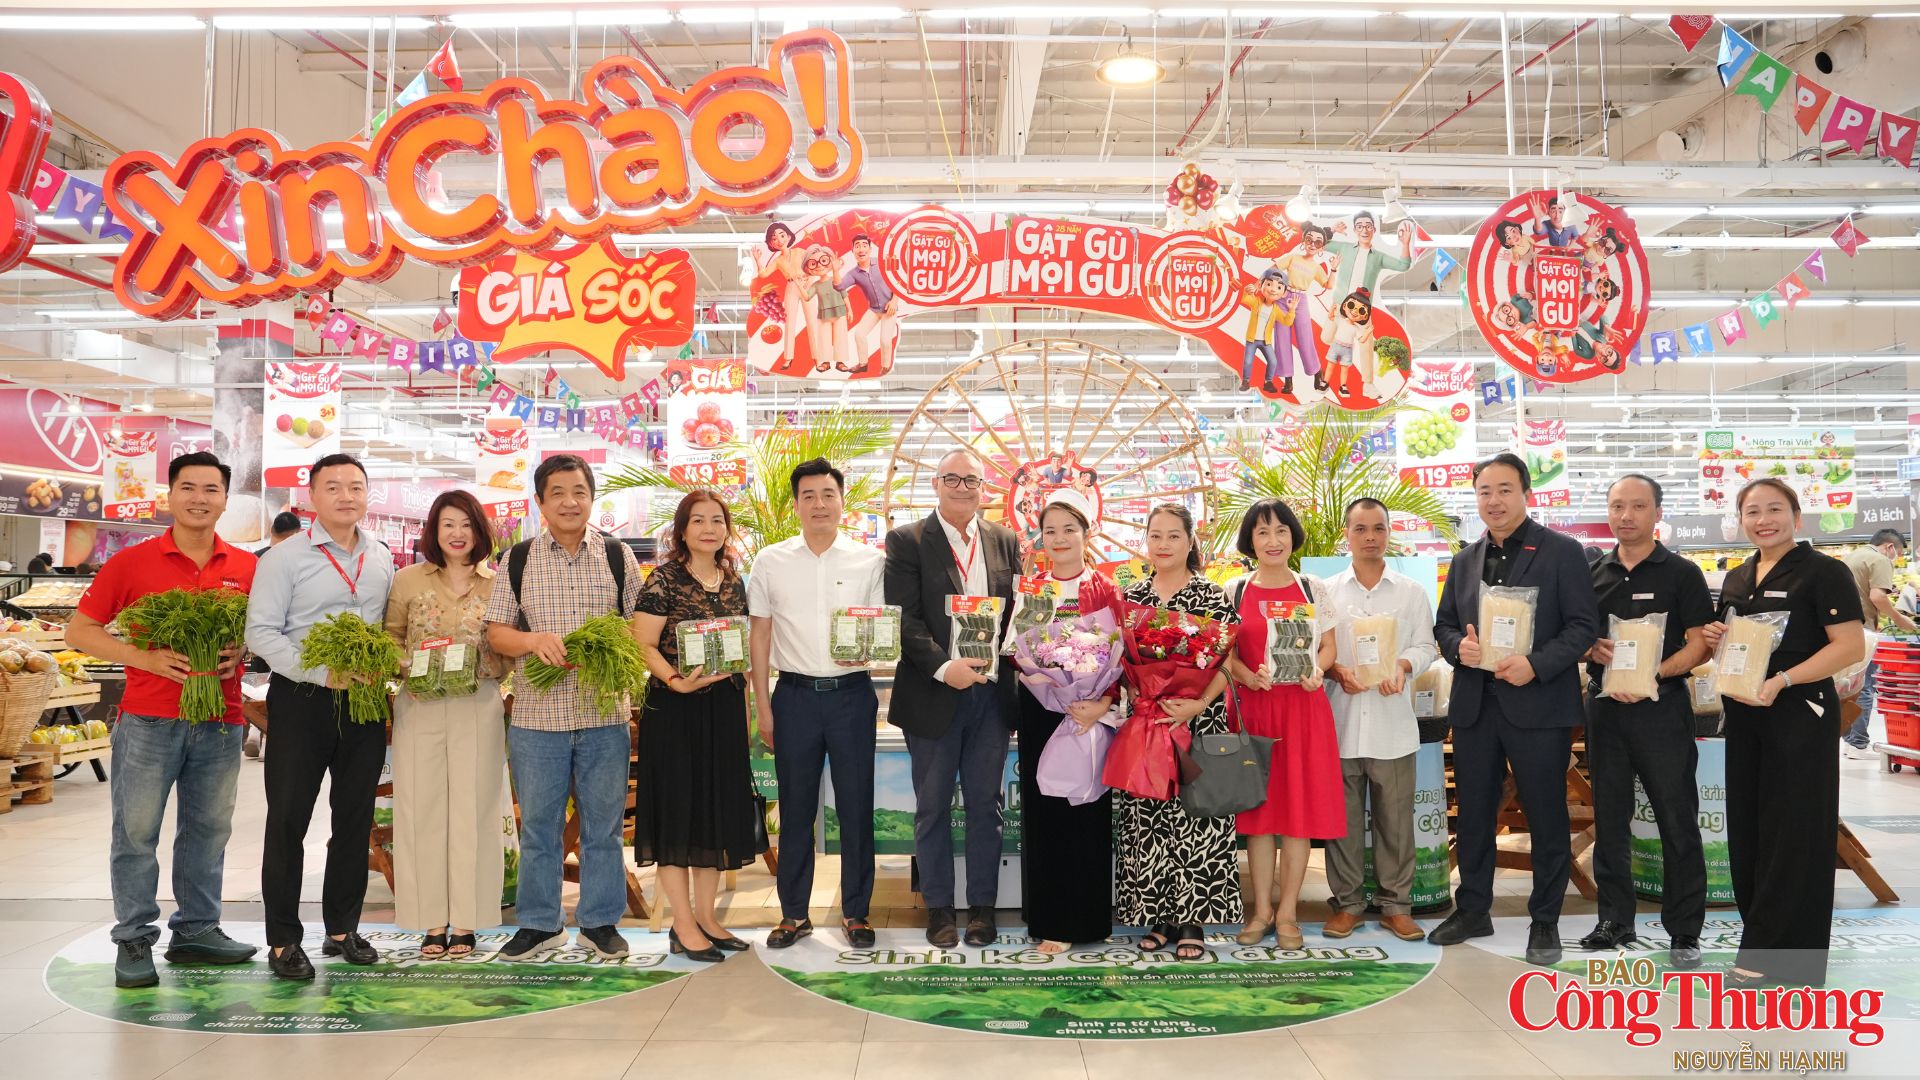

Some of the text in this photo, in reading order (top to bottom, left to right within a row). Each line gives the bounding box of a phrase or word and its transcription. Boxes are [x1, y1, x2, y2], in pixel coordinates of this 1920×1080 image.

[911, 233, 951, 248] GẬT GÙ
[1014, 220, 1127, 261] GẬT GÙ
[912, 249, 947, 268] MỌI
[1172, 259, 1212, 274] GẬT GÙ
[1012, 260, 1131, 297] MỌI GU
[1539, 260, 1579, 278] GẬT GÙ
[912, 269, 943, 291] GU
[1175, 274, 1208, 293] MỌI
[1541, 278, 1575, 299] MỌI
[476, 256, 677, 326] GIÁ SỐC
[1175, 295, 1206, 317] GU
[1542, 301, 1573, 326] GU
[691, 361, 733, 389] GIÁ
[320, 408, 336, 417] 3+1
[1863, 507, 1904, 524] Xà lách
[1676, 527, 1706, 539] Đậu phụ
[836, 949, 966, 964] Sinh
[1153, 1020, 1196, 1028] làng,
[1187, 1025, 1218, 1033] GO!
